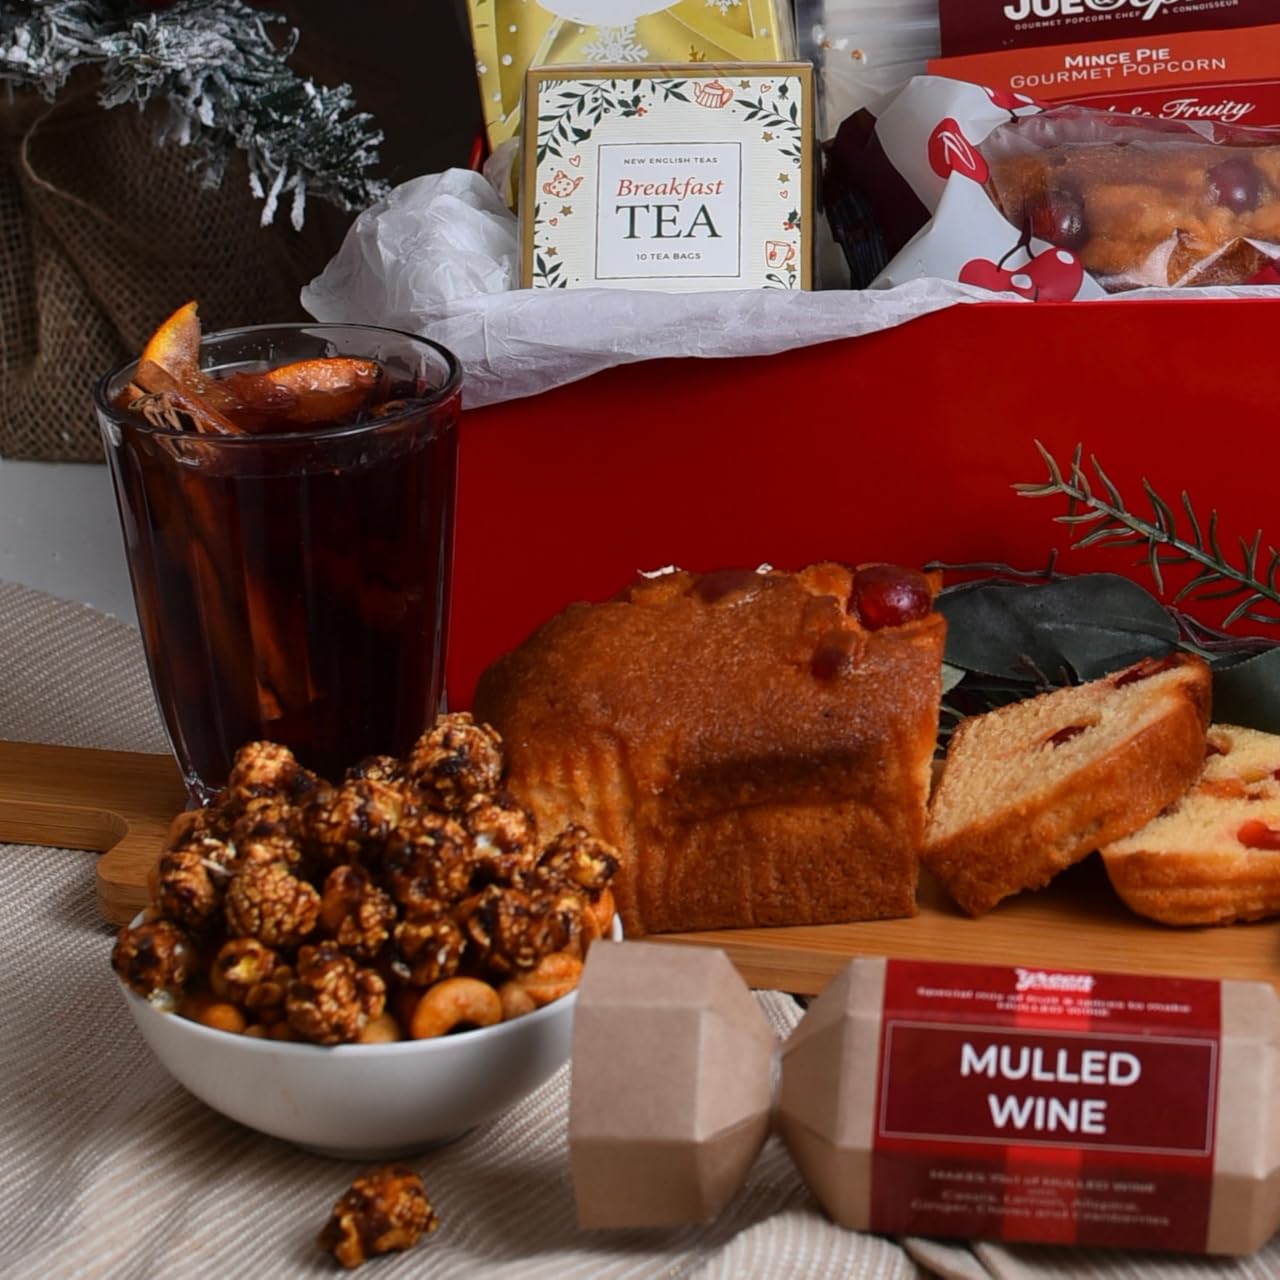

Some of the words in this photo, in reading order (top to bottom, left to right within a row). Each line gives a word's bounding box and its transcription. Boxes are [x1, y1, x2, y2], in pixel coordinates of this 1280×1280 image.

[1014, 19, 1062, 31] GOURMET
[1065, 13, 1113, 25] POPCORN
[1115, 10, 1141, 20] CHEF
[1064, 51, 1131, 69] MINCE
[1136, 47, 1171, 62] PIE
[1010, 67, 1114, 89] GOURMET
[1122, 57, 1227, 77] POPCORN
[1158, 97, 1256, 122] Fruity
[623, 157, 646, 165] NEW
[649, 157, 691, 165] ENGLISH
[615, 176, 725, 201] Breakfast
[615, 203, 723, 240] TEA
[636, 253, 648, 261] 10
[650, 252, 670, 260] TEA
[673, 252, 702, 260] BAGS
[959, 1041, 1142, 1087] MULLED
[987, 1093, 1108, 1134] WINE
